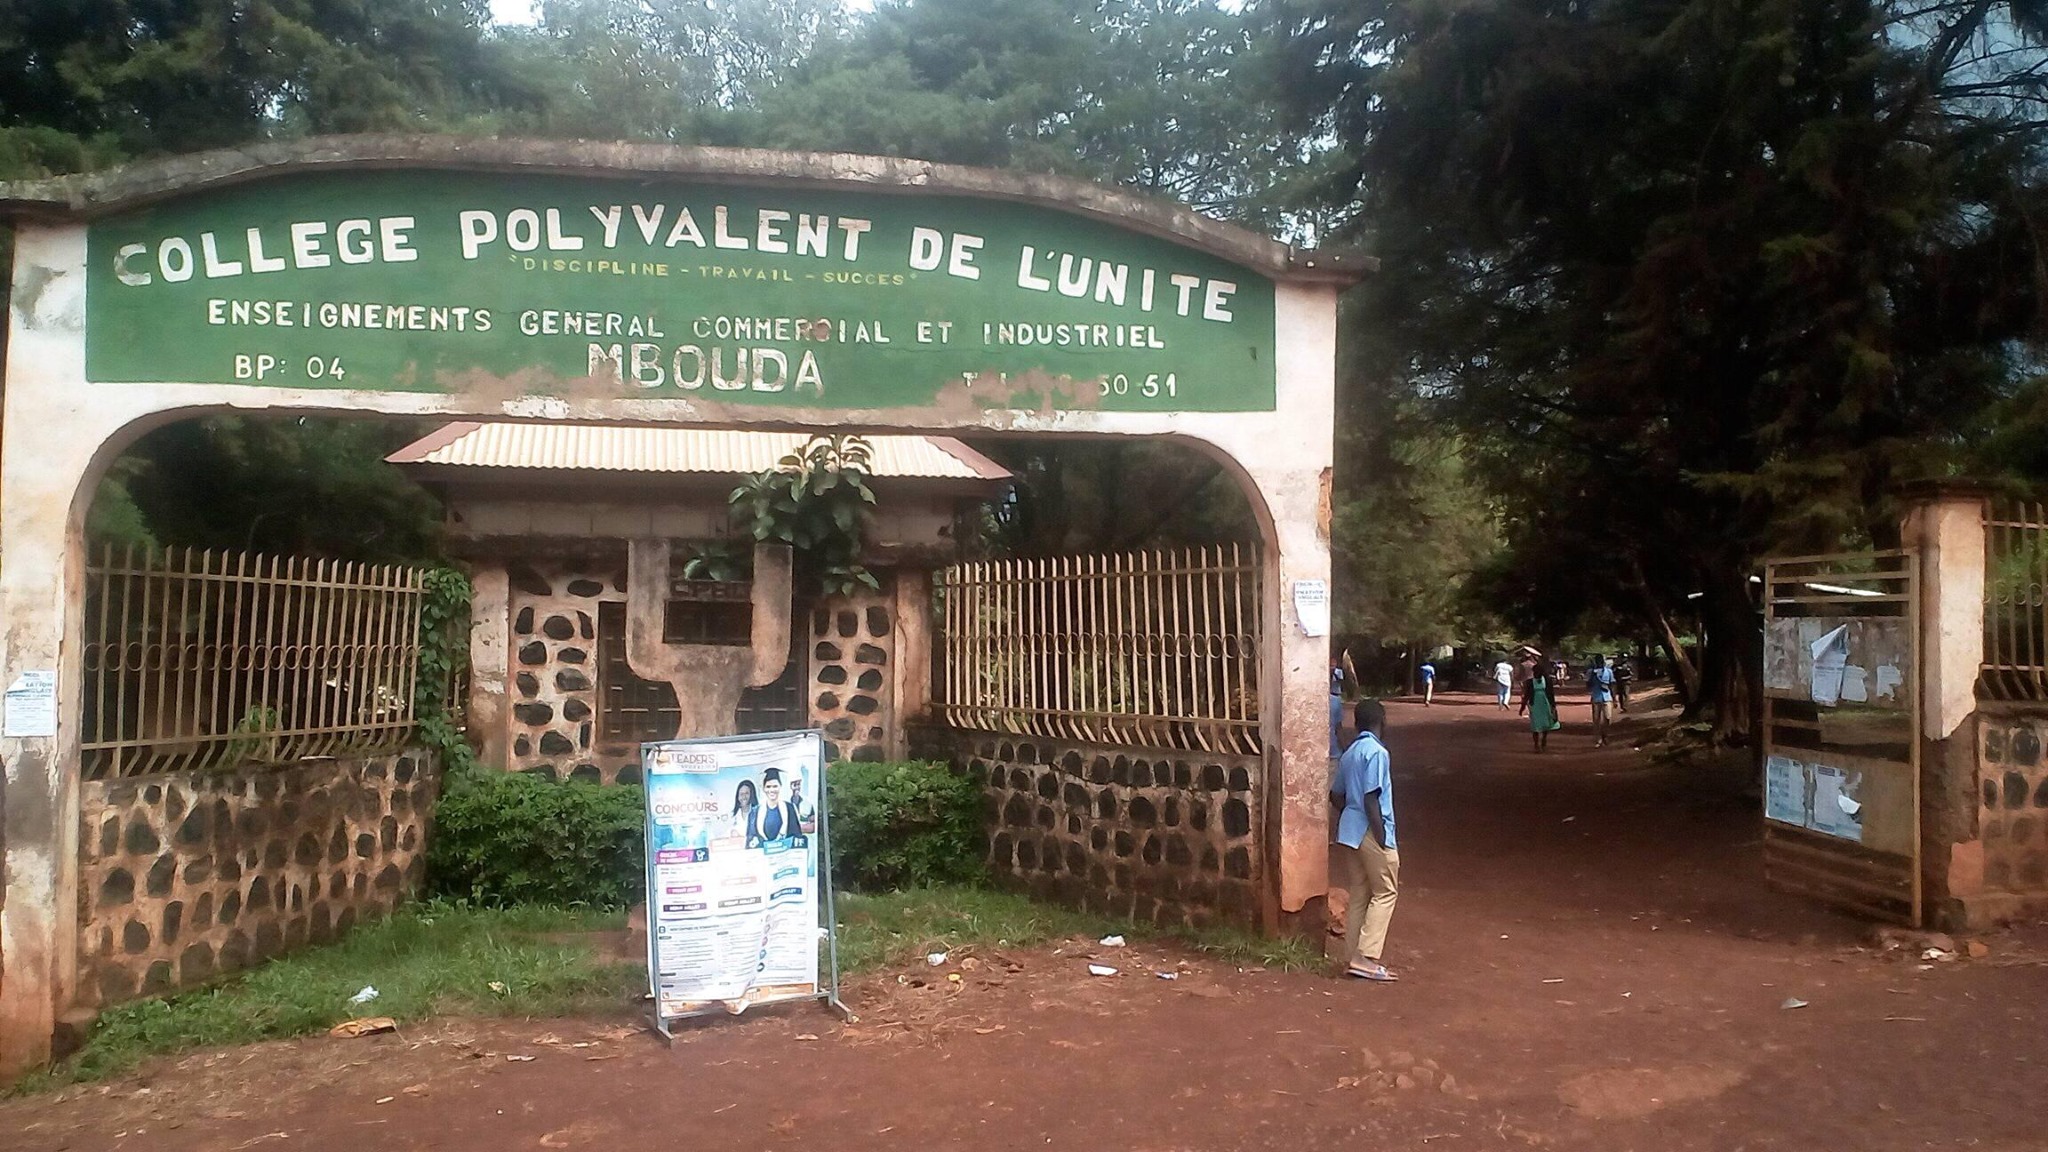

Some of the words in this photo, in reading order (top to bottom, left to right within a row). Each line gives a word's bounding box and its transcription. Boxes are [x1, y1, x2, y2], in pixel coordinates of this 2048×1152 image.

[113, 216, 418, 287] COLLEGE
[459, 204, 872, 266] POLYVALENT
[909, 226, 984, 280] DE
[1017, 245, 1238, 323] L'UNITE
[698, 265, 794, 282] TRAVAIL
[208, 299, 492, 332] ENSEIGNEMENTS
[519, 310, 666, 338] GENERAL
[692, 315, 890, 344] COMMERCIAL
[917, 321, 953, 344] ET
[984, 322, 1165, 349] INDUSTRIEL
[235, 354, 286, 380] BP:
[306, 356, 346, 381] 04
[588, 343, 823, 391] MBOUDA
[1142, 373, 1177, 398] 51
[655, 802, 718, 815] CONCOURS
